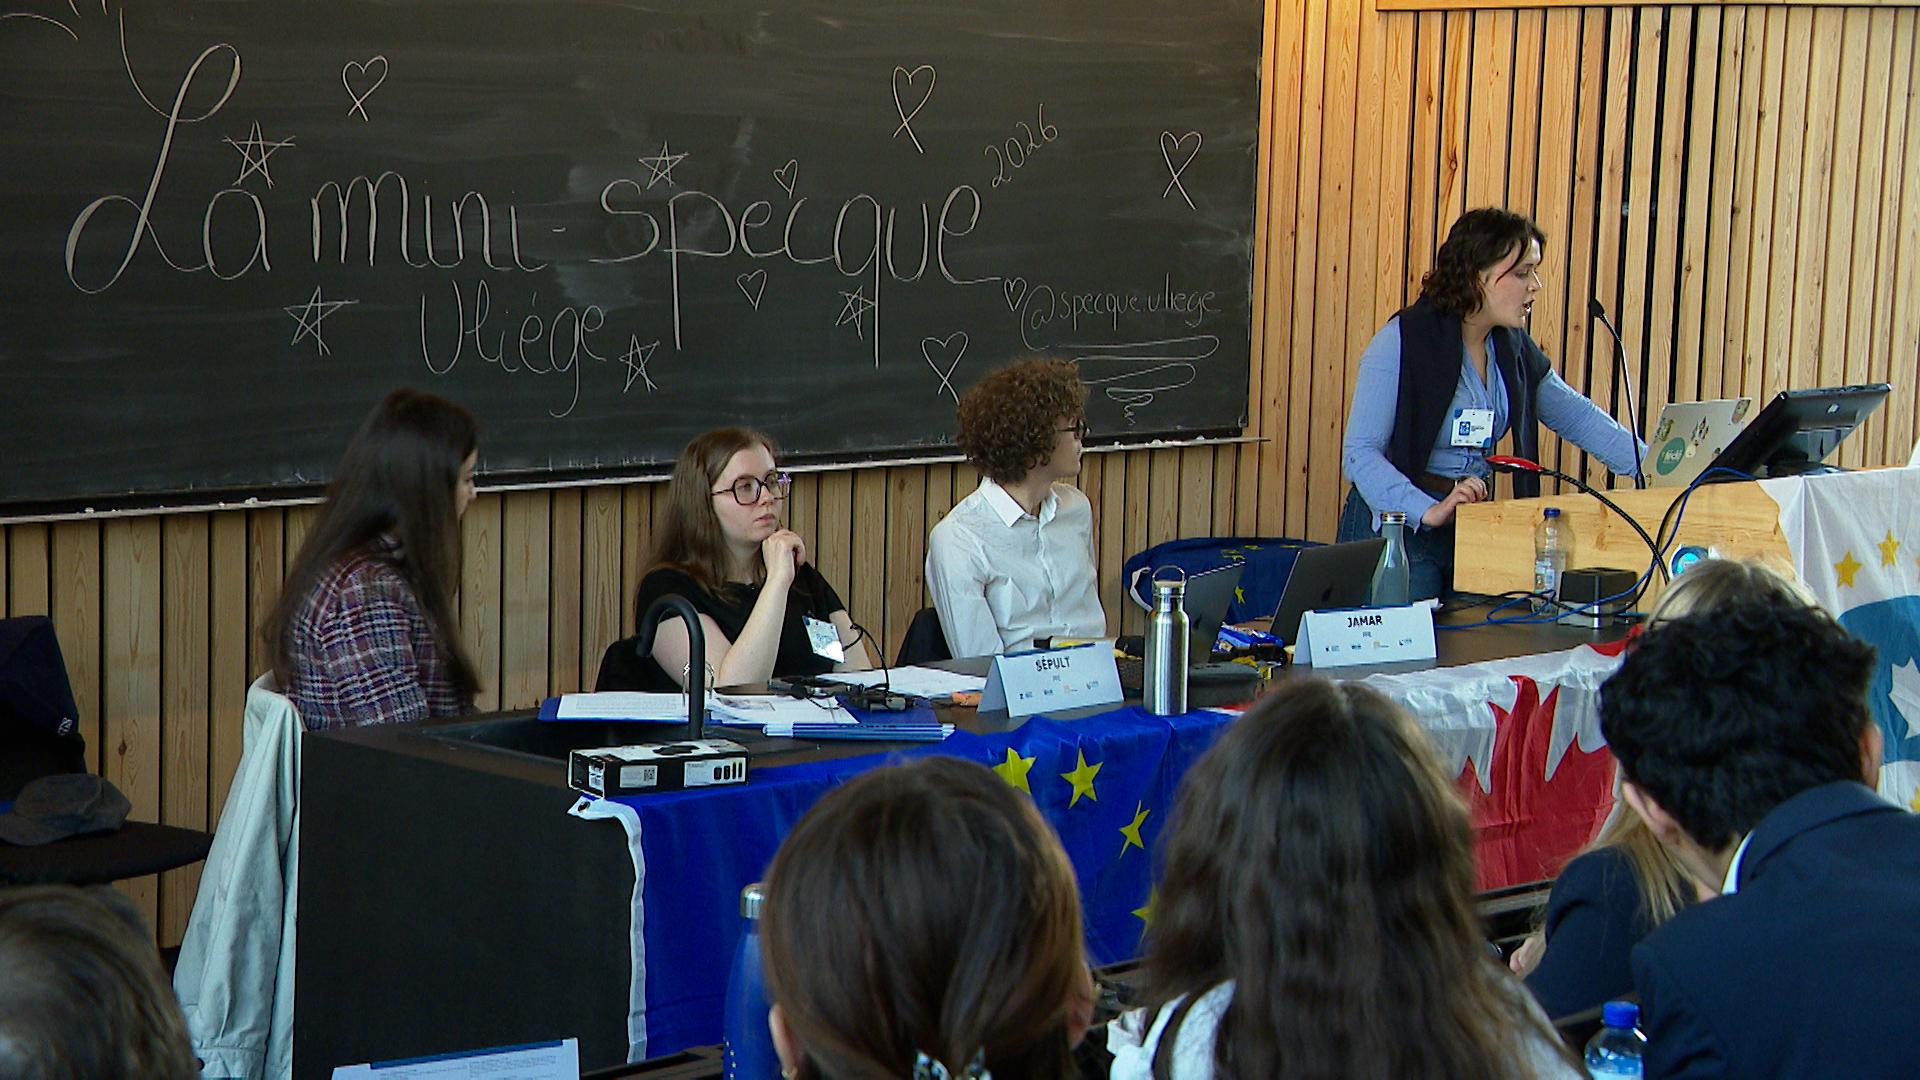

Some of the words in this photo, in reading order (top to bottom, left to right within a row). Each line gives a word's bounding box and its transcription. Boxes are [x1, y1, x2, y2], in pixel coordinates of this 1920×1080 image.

[65, 8, 272, 294] La
[984, 102, 1059, 189] 2026
[1347, 615, 1383, 628] JAMAR
[1035, 656, 1071, 672] SÉPULT
